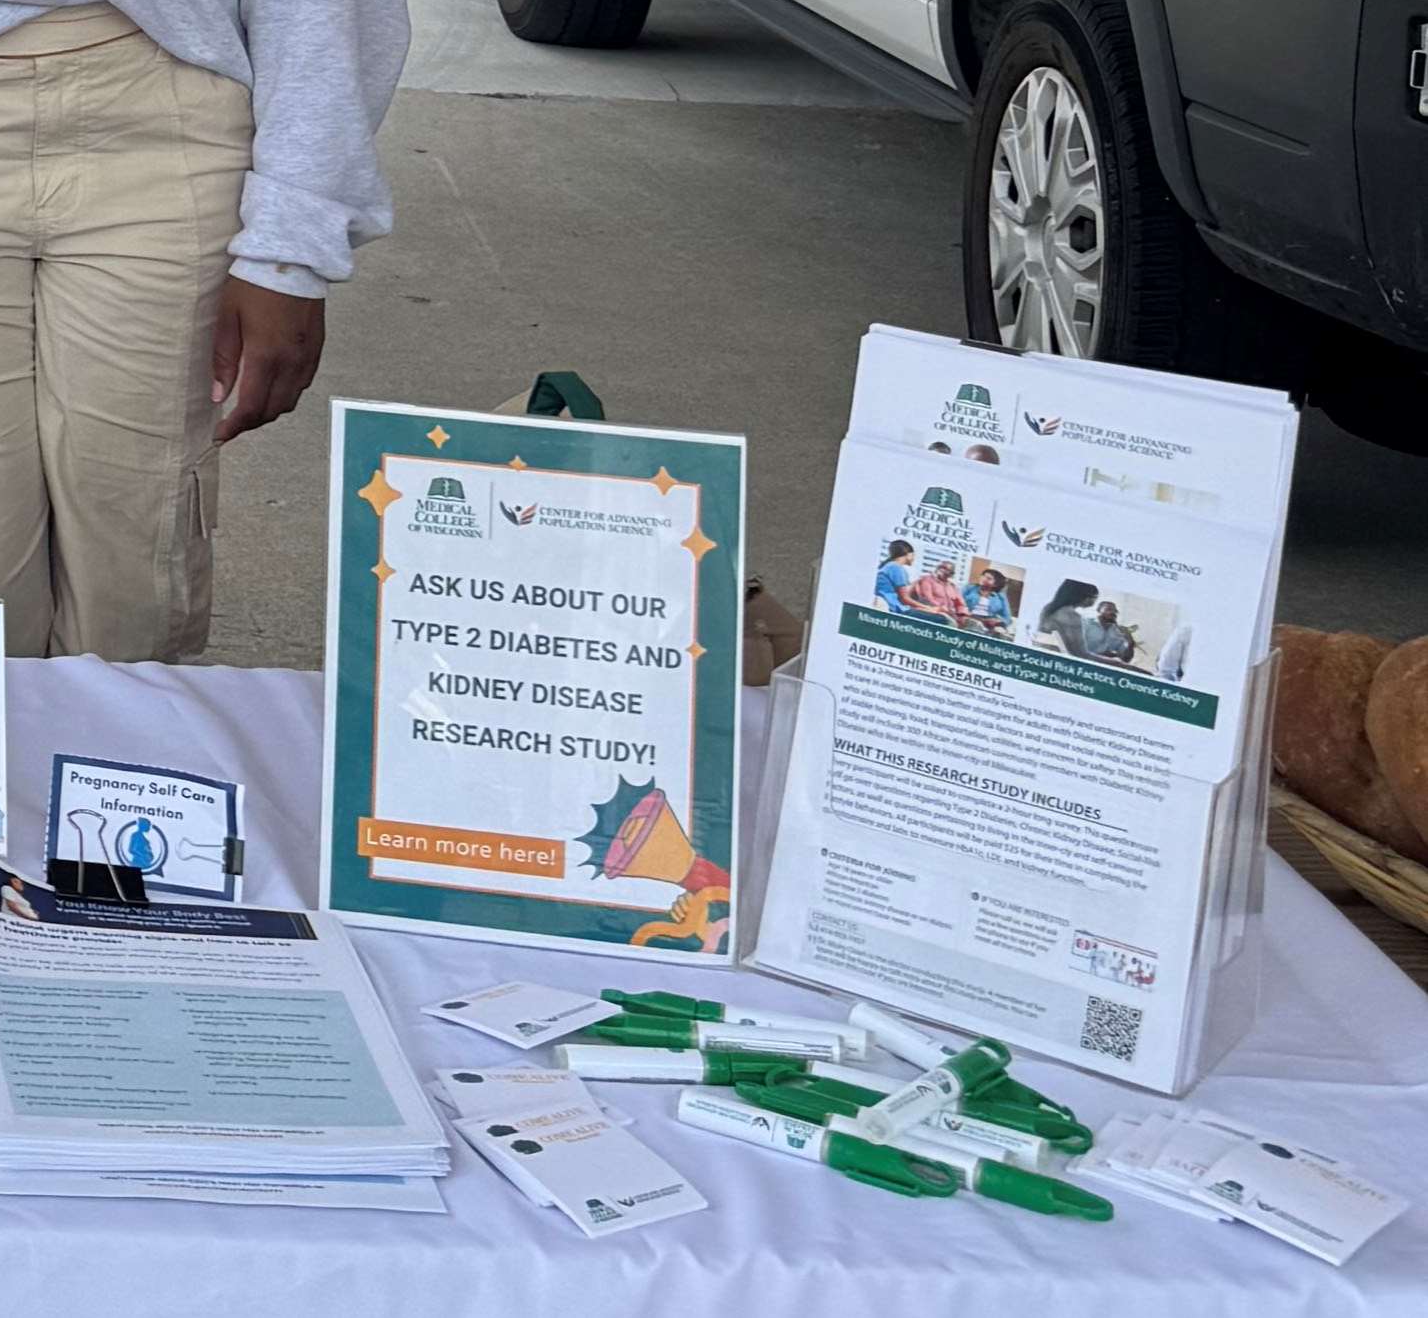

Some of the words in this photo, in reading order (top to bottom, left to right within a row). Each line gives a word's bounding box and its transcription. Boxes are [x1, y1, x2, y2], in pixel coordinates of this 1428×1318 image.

[1046, 532, 1097, 552] CENTER
[1100, 545, 1124, 558] FOR
[1126, 550, 1202, 576] ADVANCING
[1046, 544, 1123, 570] POPULATION
[1124, 562, 1178, 581] SCIENCE
[410, 573, 463, 599] ASK
[470, 578, 504, 602] US
[512, 583, 603, 613] ABOUT
[611, 593, 666, 619] OUR
[392, 619, 459, 647] TYPE
[467, 627, 481, 648] 2
[490, 630, 618, 663] DIABETES
[625, 645, 682, 669] AND
[849, 641, 896, 664] ABOUT
[899, 654, 928, 672] THIS
[931, 661, 1002, 691] RESEARCH
[429, 671, 524, 702] KIDNEY
[532, 683, 643, 715] DISEASE
[412, 722, 552, 755] RESEARCH
[559, 735, 657, 766] STUDY!
[70, 771, 146, 801] Pregnancy
[151, 780, 178, 797] Self
[180, 786, 216, 804] Care
[834, 737, 871, 760] WHAT
[874, 748, 905, 768] THIS
[907, 756, 979, 786] RESEARCH
[982, 775, 1027, 799] STUDY
[1030, 786, 1102, 820] INCLUDES
[101, 797, 183, 821] Information
[366, 828, 427, 852] Learn
[436, 839, 492, 859] more
[499, 841, 557, 866] here!
